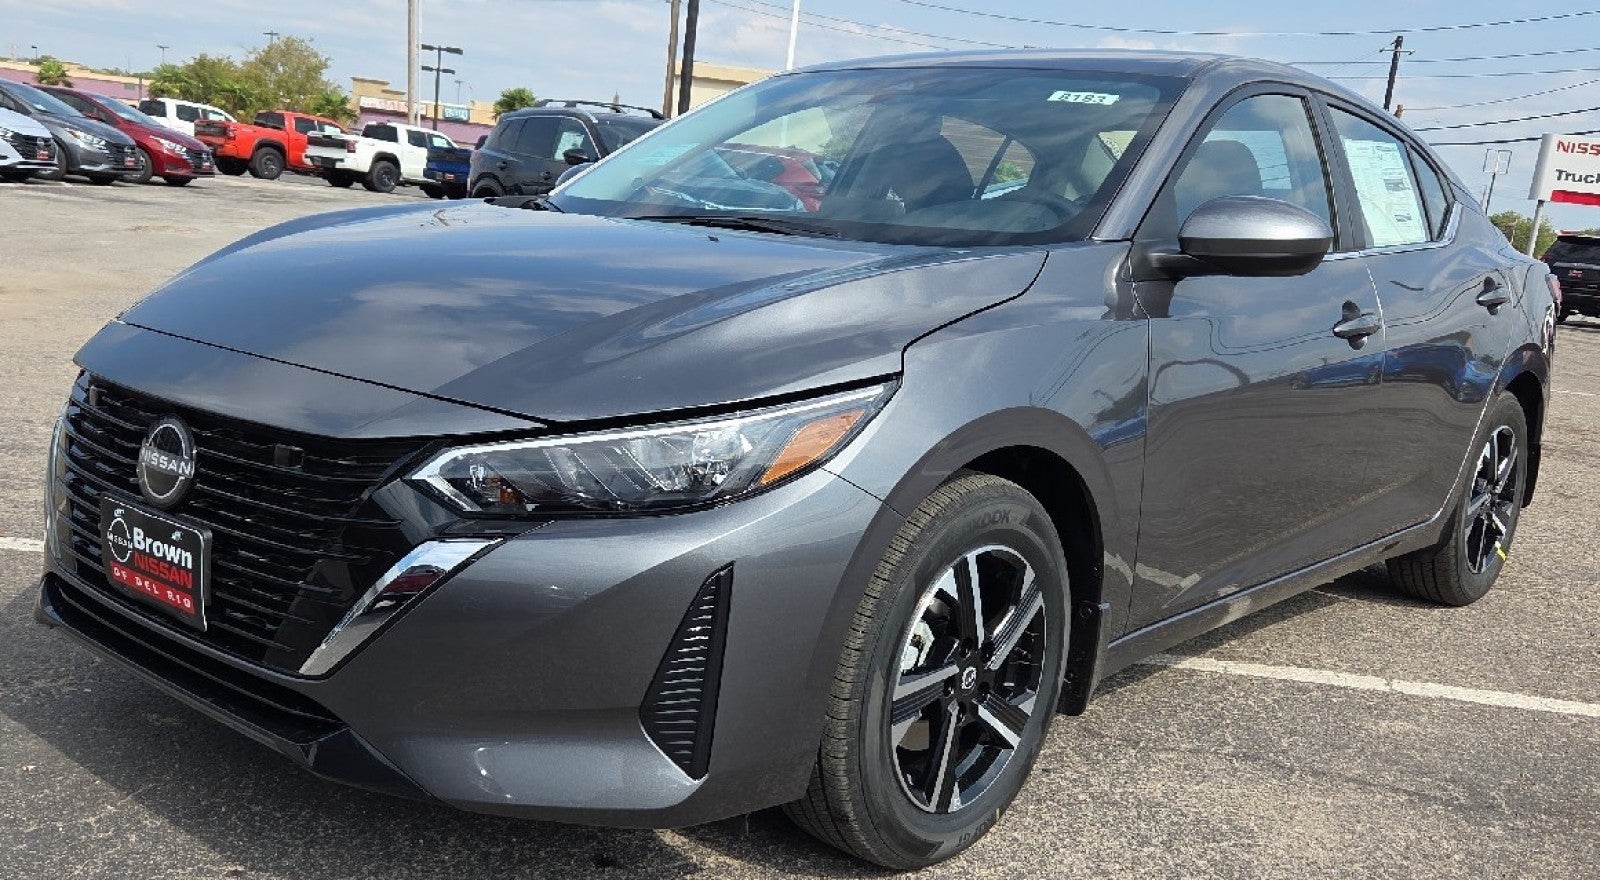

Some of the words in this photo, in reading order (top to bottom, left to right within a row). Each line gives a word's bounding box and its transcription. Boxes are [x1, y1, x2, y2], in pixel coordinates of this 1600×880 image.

[141, 447, 192, 476] NISSAN
[132, 526, 193, 570] Brown
[113, 566, 128, 580] OF
[134, 576, 160, 595] DEL
[166, 590, 191, 609] RIO
[133, 550, 193, 589] NISSAN
